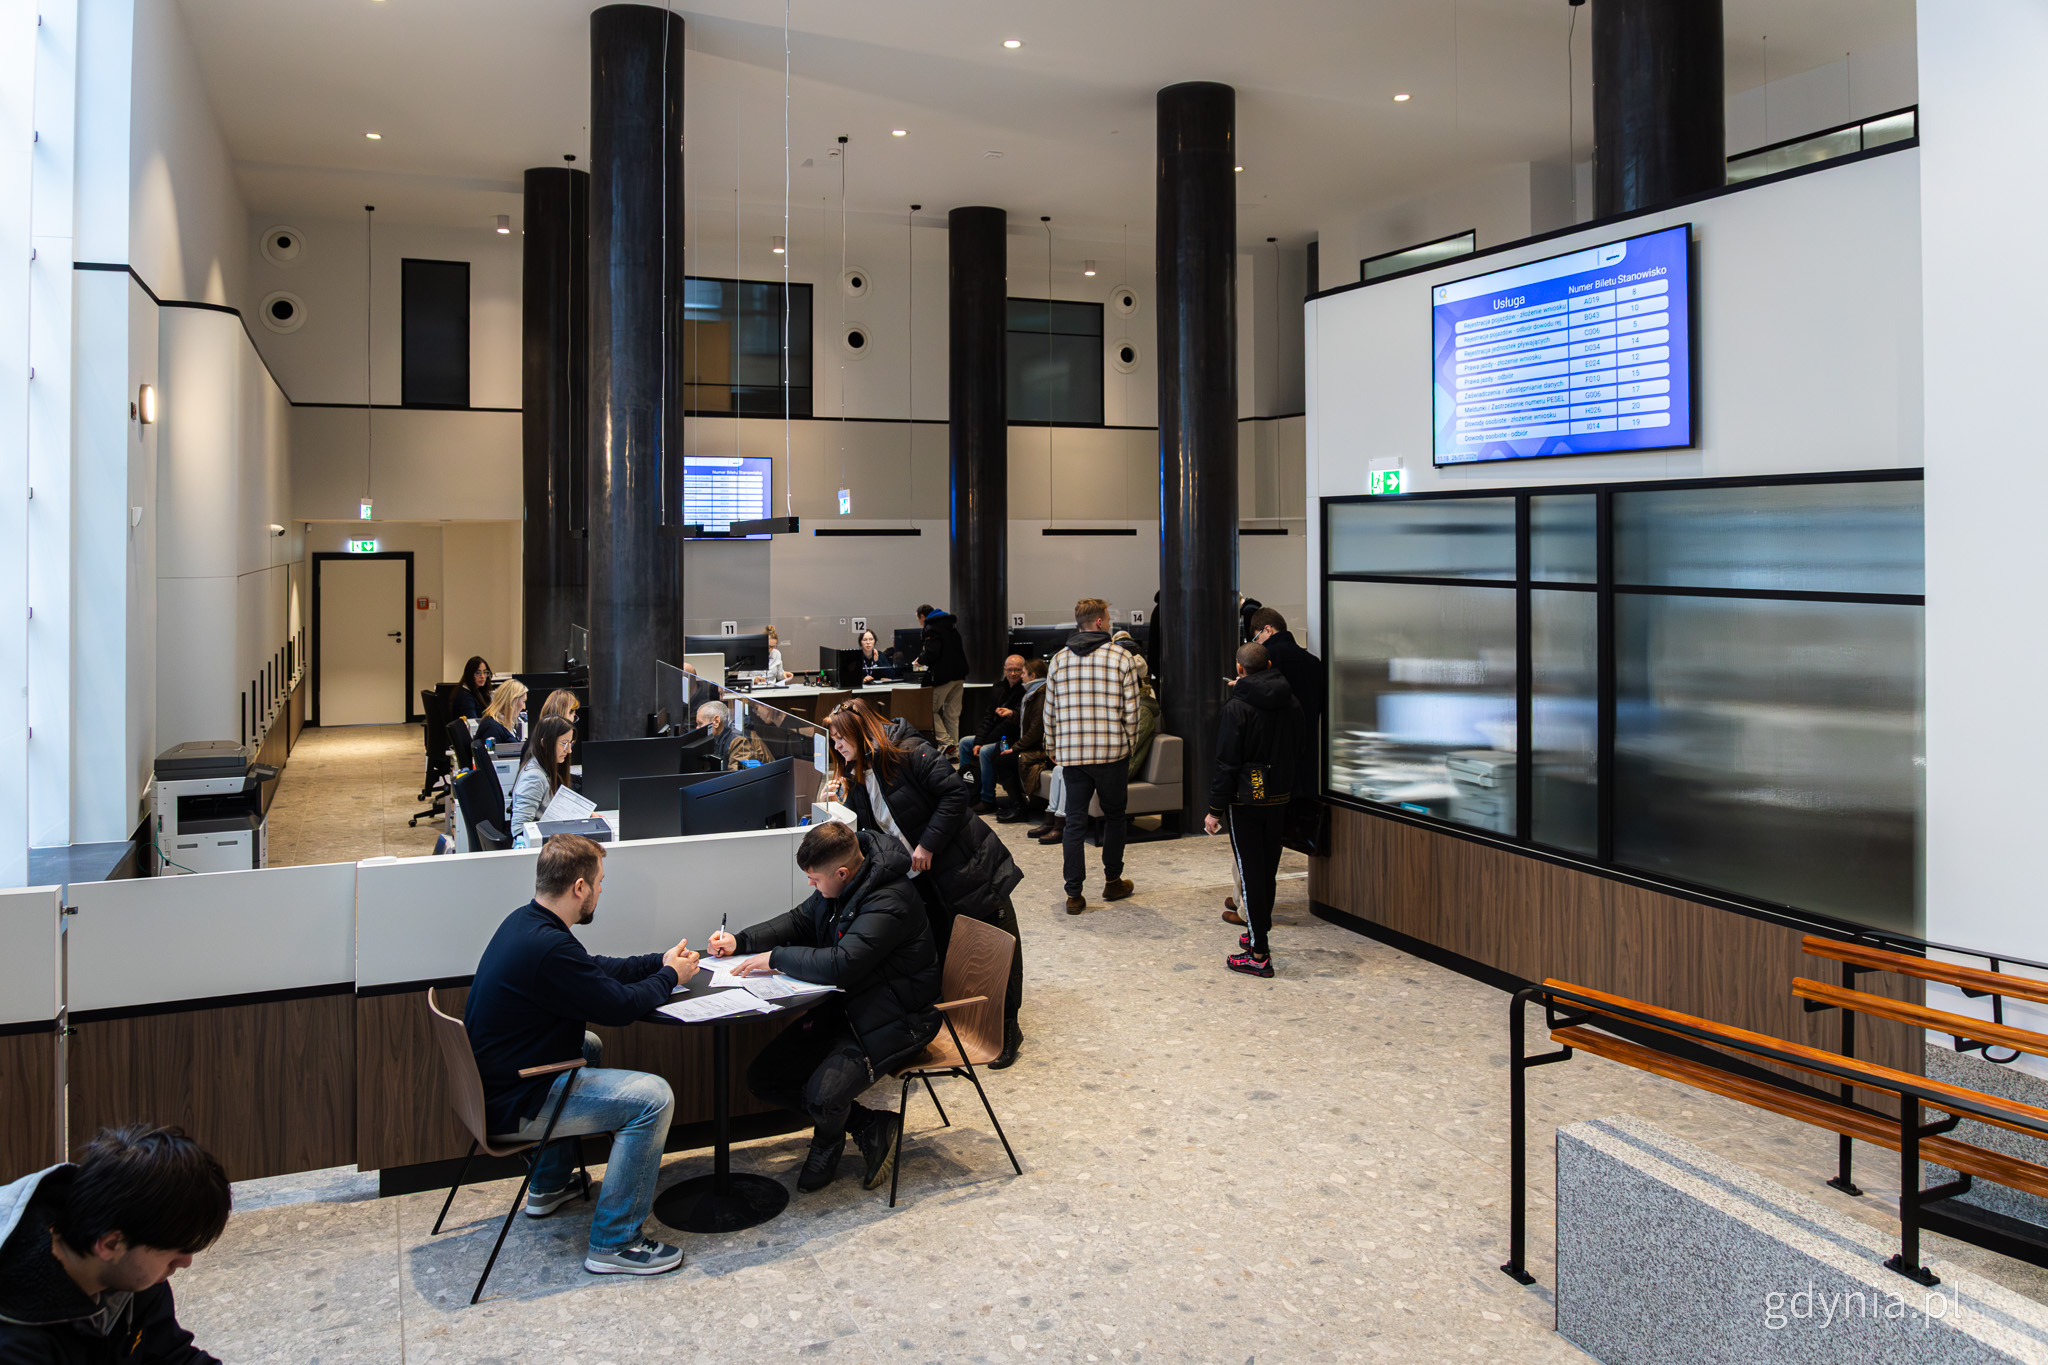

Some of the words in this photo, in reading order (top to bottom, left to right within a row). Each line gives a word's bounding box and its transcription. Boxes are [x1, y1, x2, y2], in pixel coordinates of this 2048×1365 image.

[1493, 296, 1525, 310] Usługa
[1568, 283, 1594, 294] Numer
[1595, 277, 1616, 288] Biletu
[1618, 266, 1667, 283] Stanowisko
[1464, 320, 1490, 329] Rejestracja
[1544, 303, 1566, 313] wniosku
[1584, 296, 1599, 304] A019
[1464, 334, 1489, 342] Rejestracja
[1516, 324, 1532, 332] odbiór
[1533, 321, 1553, 330] dowodu
[1584, 312, 1599, 320] B043
[1464, 347, 1490, 356] Rejestracja
[1491, 343, 1515, 352] jednostek
[1518, 337, 1550, 348] pływających
[1480, 361, 1493, 370] jazdy
[1520, 354, 1541, 362] wniosku
[1585, 359, 1600, 367] E024
[1464, 390, 1501, 399] Zaświadczenia
[1506, 384, 1542, 394] udostępnianie
[1534, 412, 1556, 420] wniosku
[854, 622, 864, 630] 12
[1014, 617, 1023, 625] 13
[725, 625, 734, 634] 11
